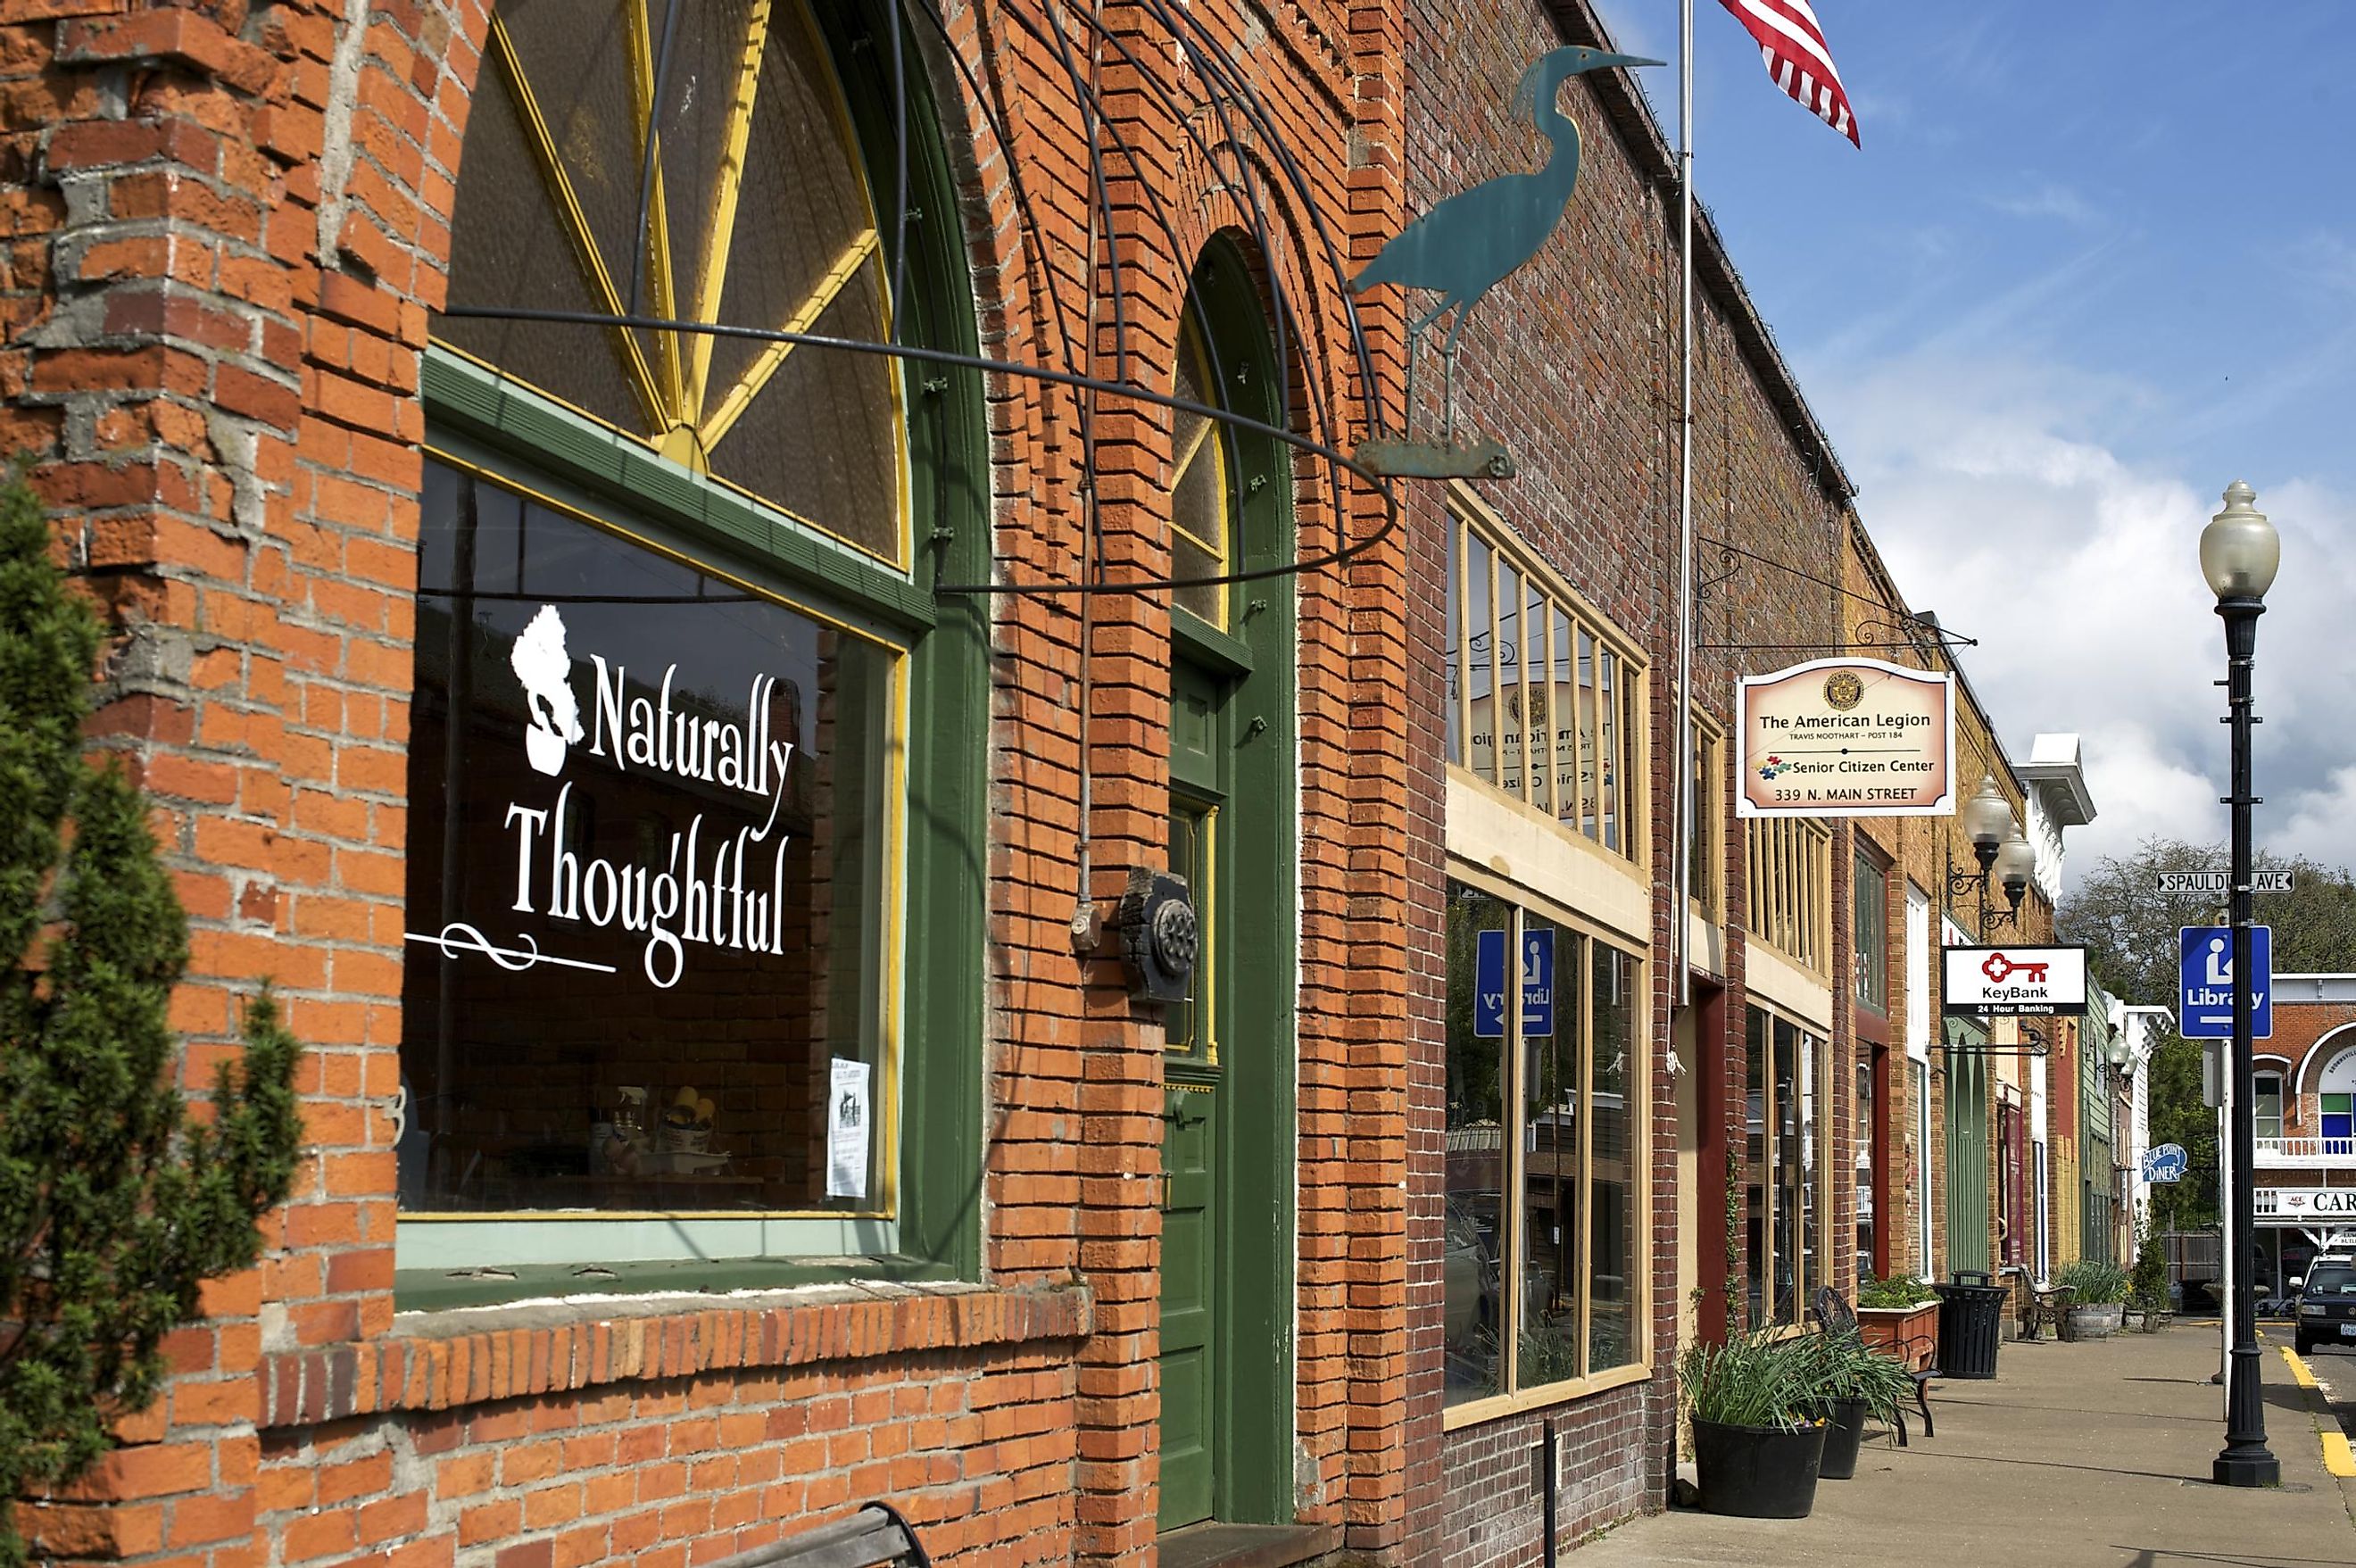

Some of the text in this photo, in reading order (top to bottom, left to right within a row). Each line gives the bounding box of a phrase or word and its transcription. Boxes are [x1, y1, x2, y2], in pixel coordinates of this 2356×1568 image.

[1760, 713, 1930, 730] The American Legion
[1789, 733, 1814, 741] TRAVIS
[589, 652, 794, 842] Naturally
[1793, 759, 1935, 774] Senior Citizen Center
[1775, 787, 1918, 801] 339 N. MAIN STREET
[504, 781, 789, 988] Thoughtful
[2167, 874, 2284, 891] SPAULDI AVE
[1982, 986, 2048, 1001] KeyBank
[1978, 1004, 2054, 1014] 24 Hour Banking
[2143, 1146, 2162, 1169] BLUE
